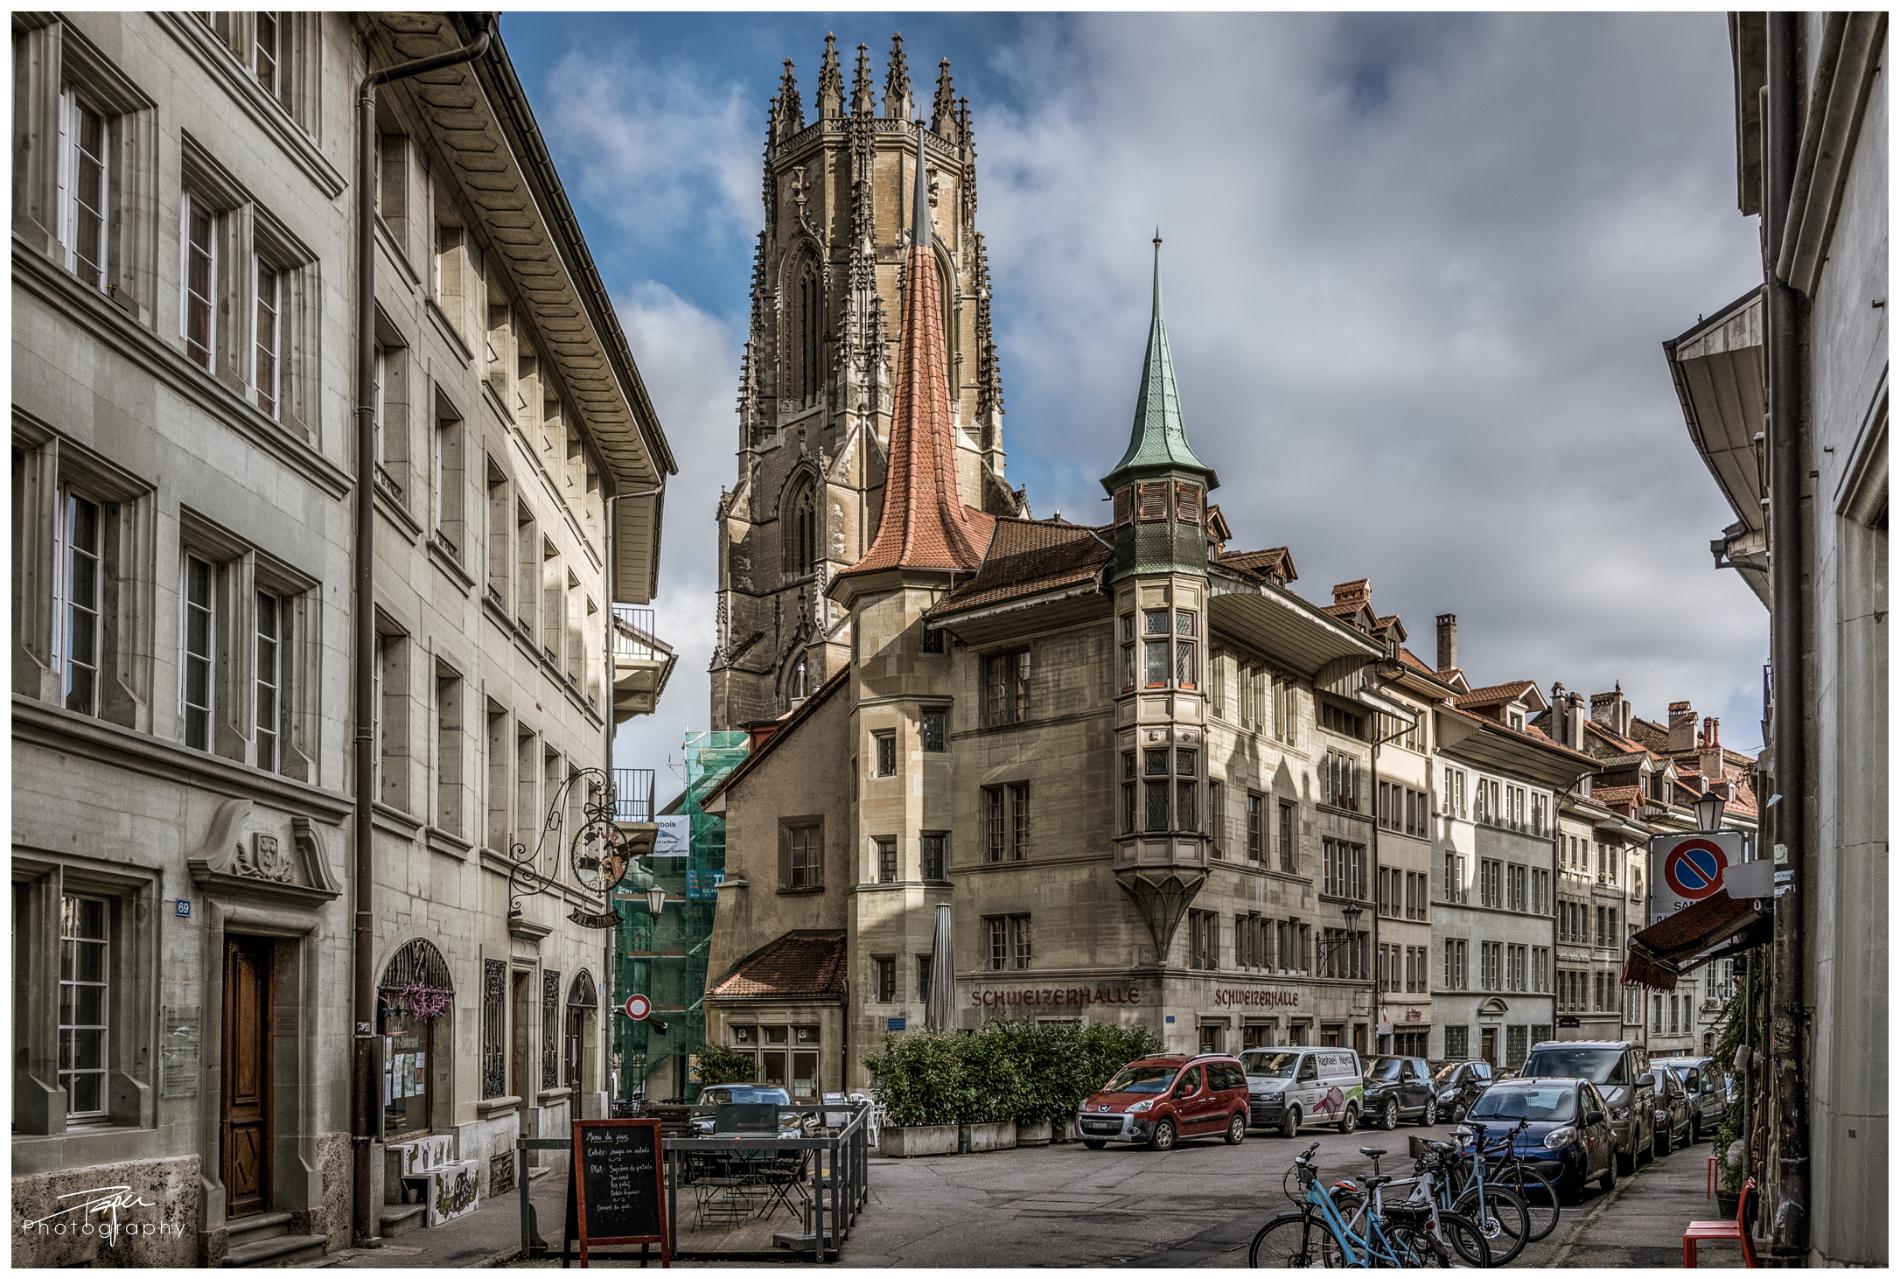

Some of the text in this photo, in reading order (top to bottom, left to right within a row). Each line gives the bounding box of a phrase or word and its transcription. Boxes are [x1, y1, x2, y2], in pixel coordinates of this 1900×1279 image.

[178, 902, 189, 913] 69
[971, 986, 1141, 1009] SCHWEIZERHALLE
[1214, 989, 1299, 1010] SCHWEIZERHALLE
[586, 1131, 602, 1143] Menu
[604, 1130, 613, 1140] du
